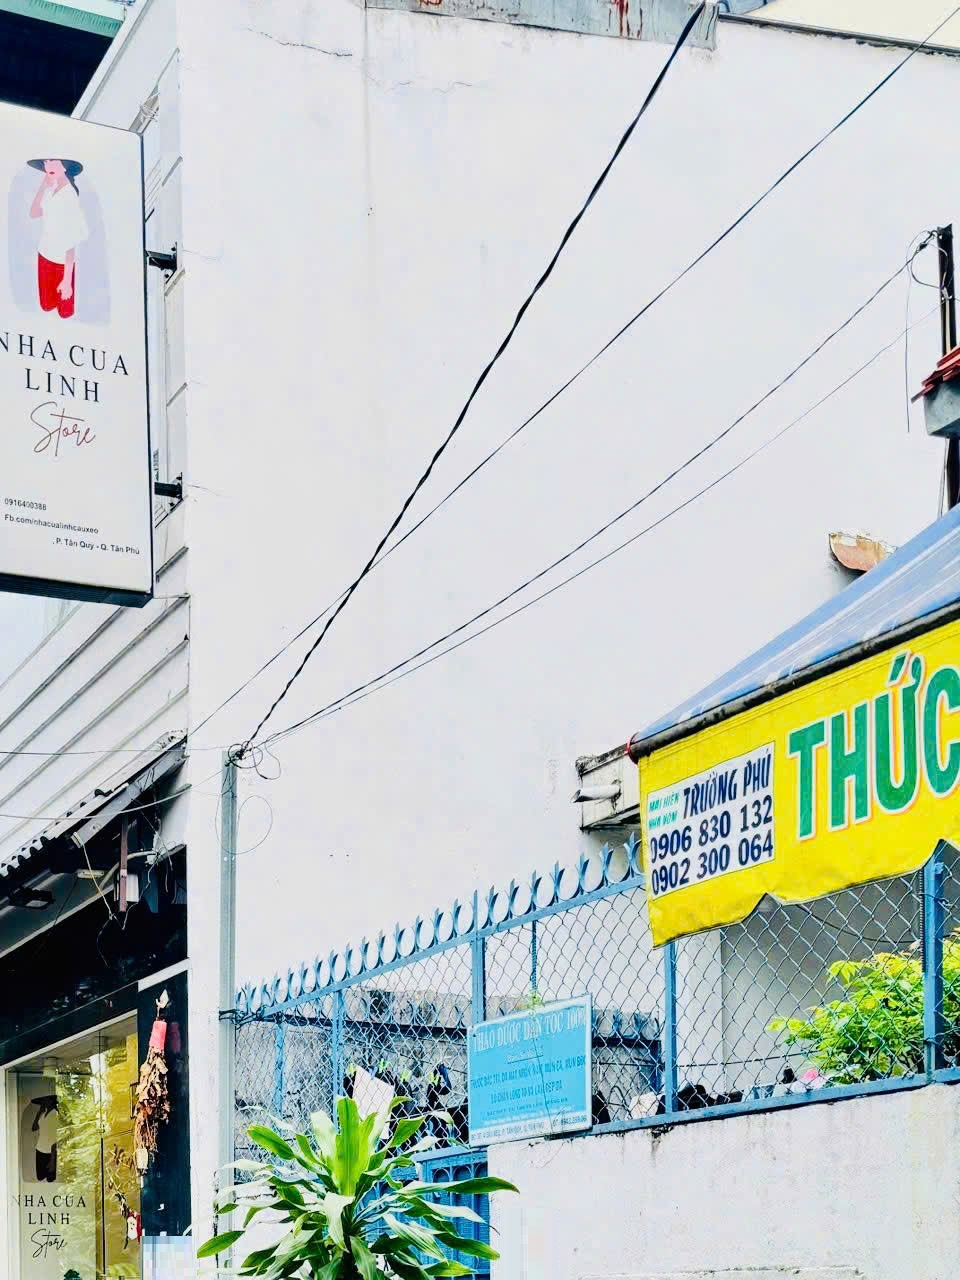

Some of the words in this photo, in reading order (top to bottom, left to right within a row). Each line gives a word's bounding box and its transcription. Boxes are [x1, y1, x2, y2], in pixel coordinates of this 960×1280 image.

[69, 345, 129, 376] CUA
[25, 368, 100, 403] LINH
[30, 401, 96, 457] Store
[787, 650, 960, 840] THỨC
[650, 825, 692, 864] 0906
[698, 810, 731, 847] 830
[740, 794, 773, 832] 132
[651, 857, 690, 896] 0902
[697, 844, 730, 880] 300
[738, 829, 773, 866] 064
[28, 1212, 70, 1225] LINH
[30, 1228, 68, 1259] Store
